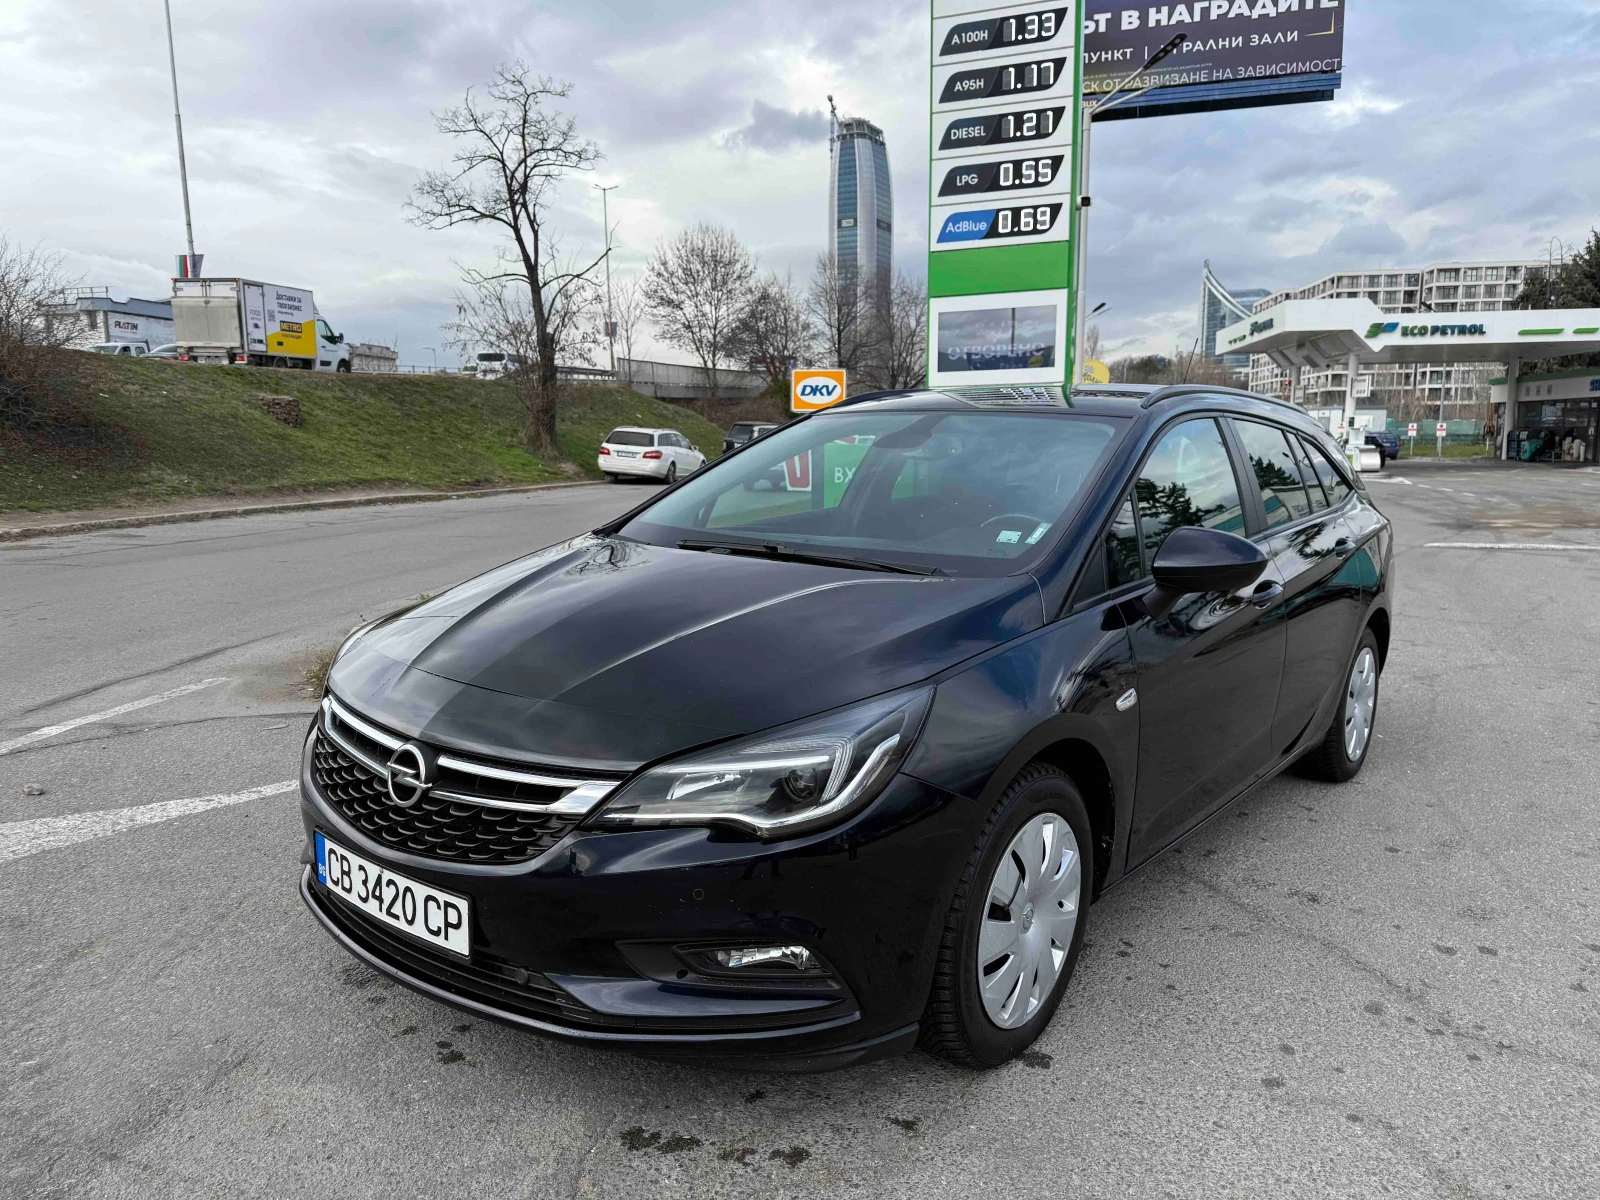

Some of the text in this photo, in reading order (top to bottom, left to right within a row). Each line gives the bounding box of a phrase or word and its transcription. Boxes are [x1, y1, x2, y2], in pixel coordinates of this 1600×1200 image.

[1008, 12, 1056, 42] 1.33
[1121, 10, 1141, 31] В
[1161, 35, 1243, 55] РАЛНИ
[1249, 30, 1299, 46] ЗАЛИ
[953, 61, 1055, 93] A95H 1.17
[1102, 78, 1122, 91] ОТ
[1212, 67, 1233, 80] НА
[1236, 58, 1341, 79] ЗАВИСИМОСТ
[950, 110, 1054, 140] DIESEL 1.21
[956, 158, 1053, 187] LPG 0.55
[945, 206, 1051, 234] AdBlue 0.69
[280, 322, 302, 332] METRO
[1401, 323, 1487, 337] ECO PETROL
[947, 341, 1046, 361] ОТВОРЕНО
[800, 384, 839, 397] DKV
[318, 863, 326, 877] BG
[327, 847, 463, 942] CB 3420 CP
